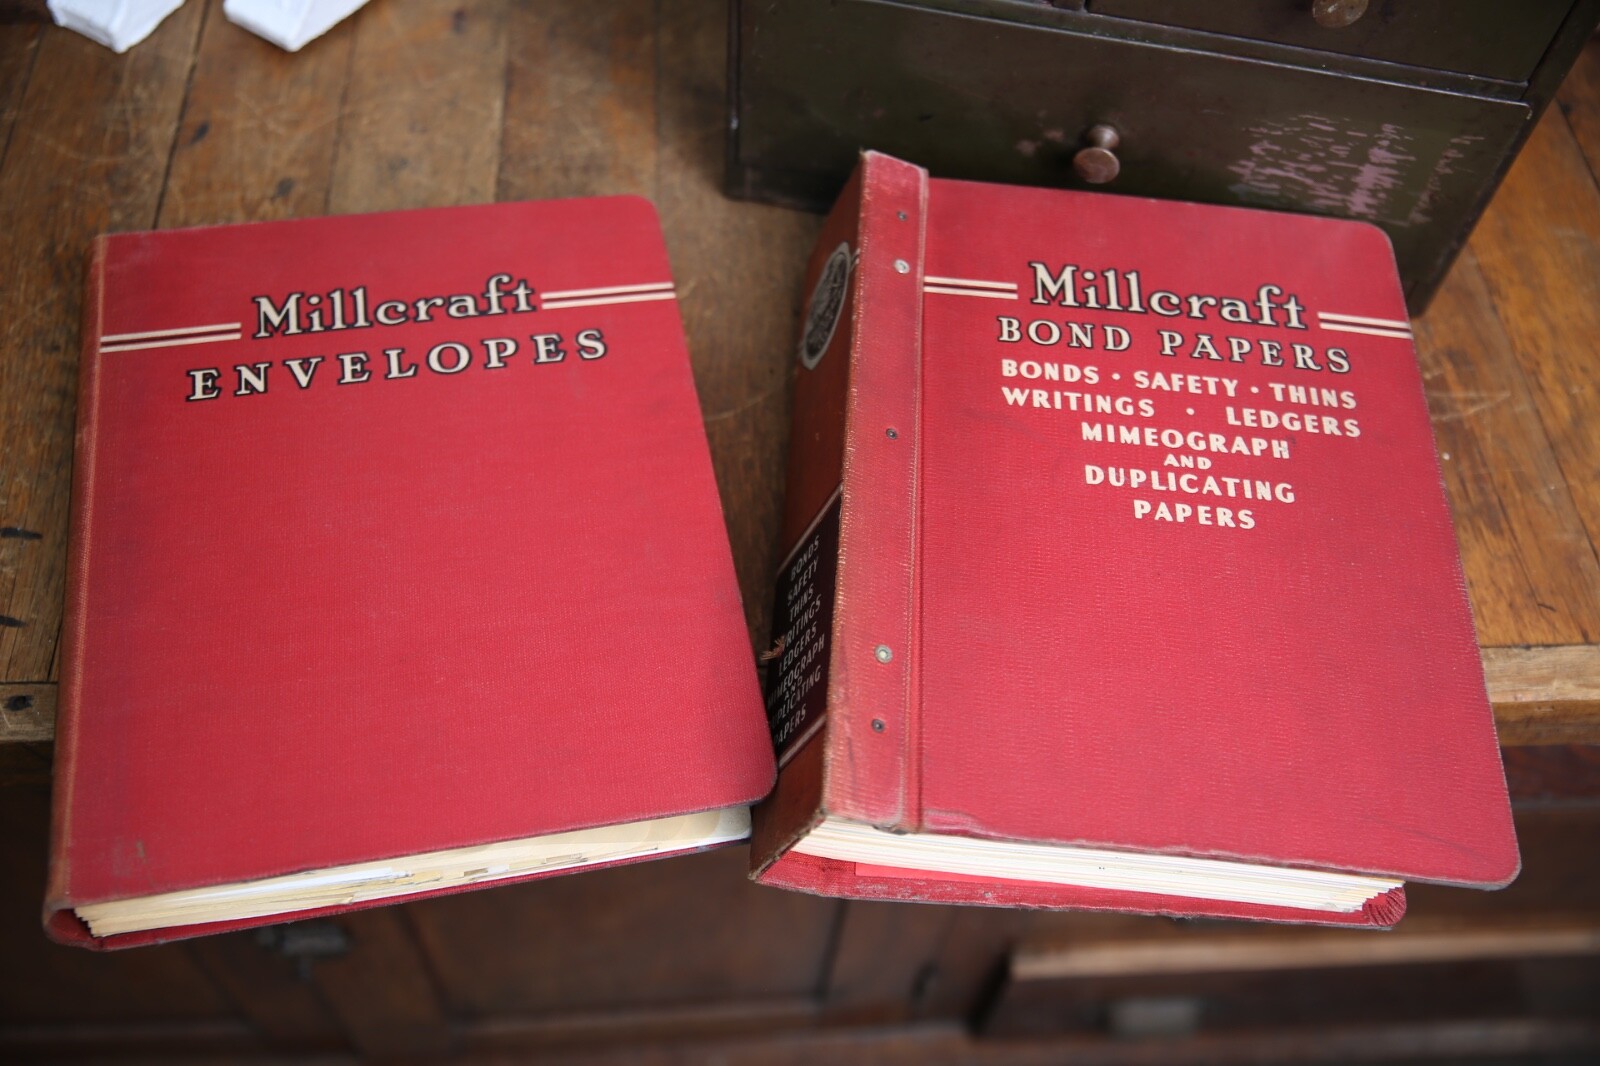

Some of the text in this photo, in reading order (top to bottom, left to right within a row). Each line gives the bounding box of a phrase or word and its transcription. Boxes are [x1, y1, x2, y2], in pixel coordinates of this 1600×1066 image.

[252, 274, 536, 340] Millcraft
[1029, 261, 1307, 330] Millcraft
[186, 328, 608, 402] ENVELOPES
[997, 315, 1351, 374] BOND PAPERS
[1001, 358, 1357, 410] BONDS SAFETY THINS
[1001, 386, 1361, 438] WRITINGS LEDGERS
[1080, 421, 1290, 460] MIMEOGRAPH
[1163, 453, 1212, 470] AND
[1084, 464, 1295, 504] DUPLICATING
[1133, 499, 1256, 530] PAPERS
[787, 555, 819, 607] SAFETY
[790, 534, 820, 582] BONDS
[783, 593, 822, 648] RITINGS
[789, 582, 814, 623] THINS
[778, 620, 817, 678] LEDGERS
[784, 675, 803, 702] AND
